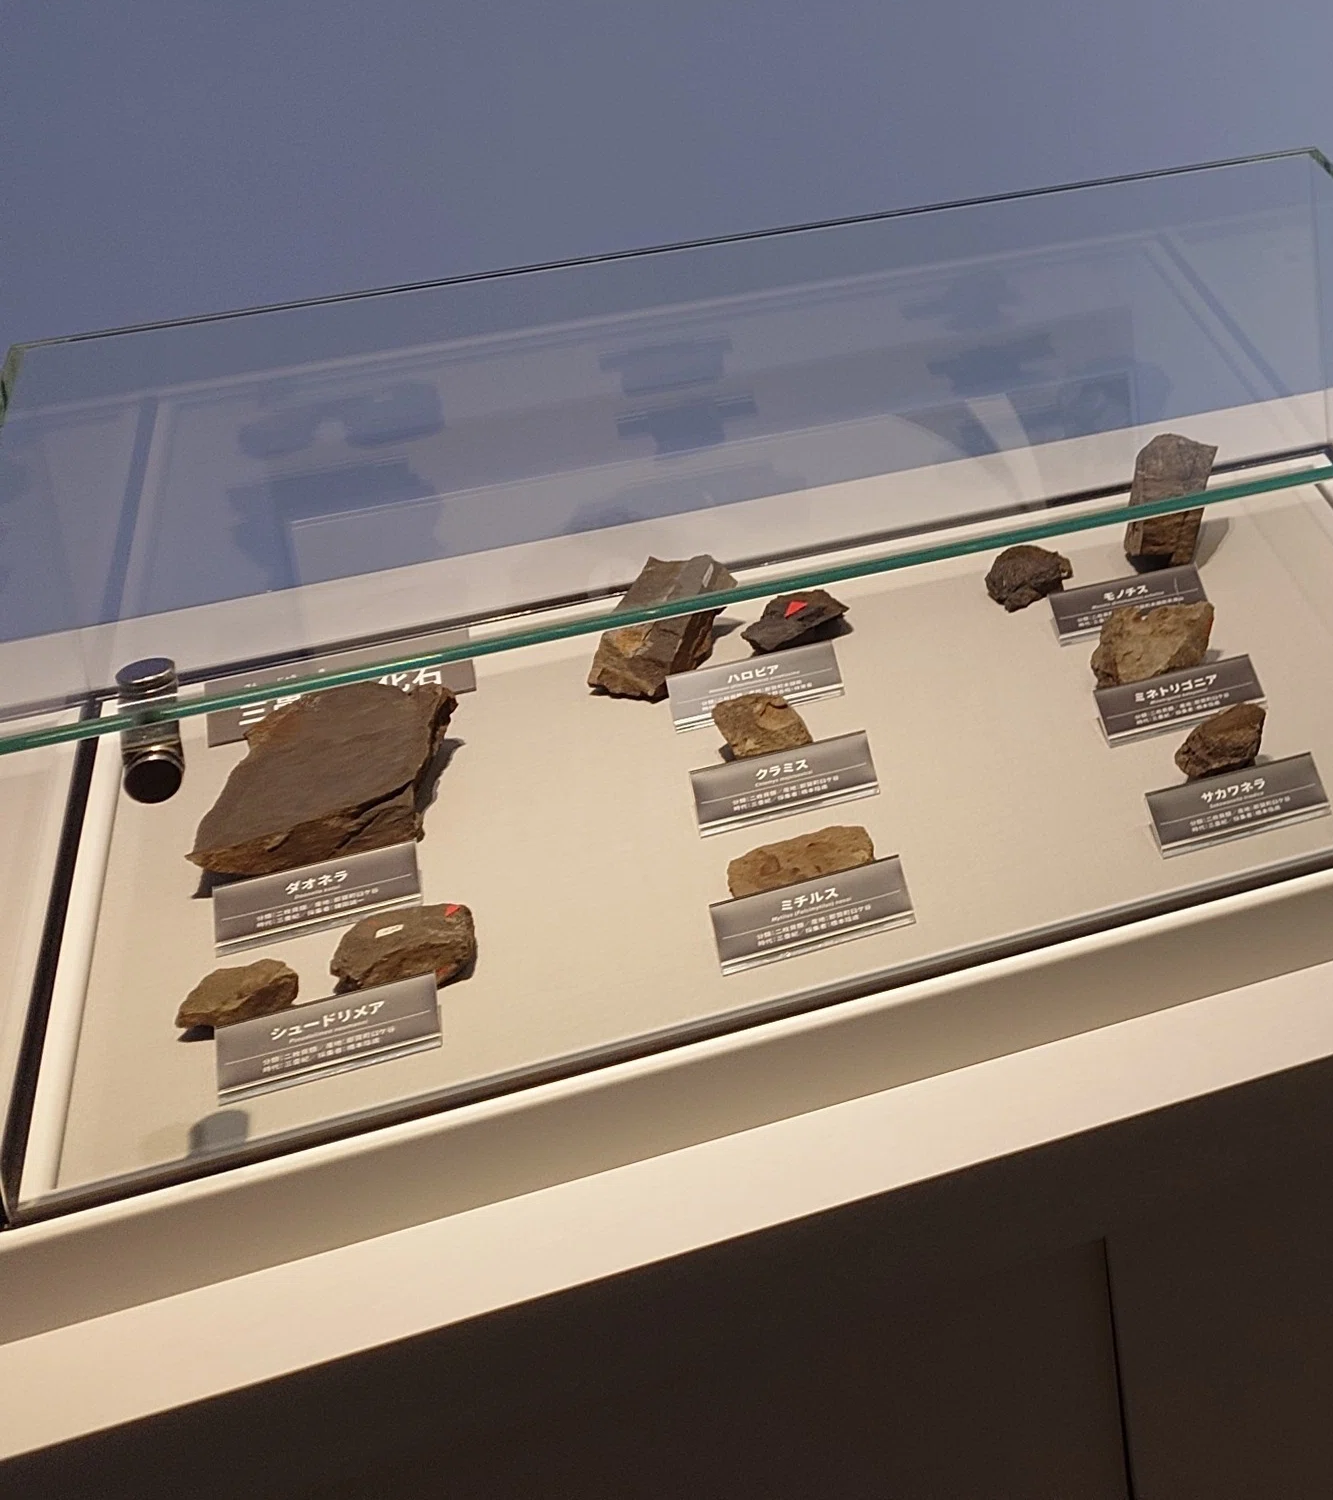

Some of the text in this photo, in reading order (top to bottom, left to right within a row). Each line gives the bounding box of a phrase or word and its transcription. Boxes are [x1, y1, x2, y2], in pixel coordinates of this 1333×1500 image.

[1104, 584, 1148, 601] モノチス
[727, 664, 779, 684] ハロビア
[1134, 674, 1217, 702] ミネトリゴニア
[755, 758, 809, 782] クラミス
[1201, 778, 1266, 803] サカワネラ
[286, 870, 348, 896] ダオネラ
[780, 887, 839, 911] ミチルス
[270, 1000, 385, 1041] シュードリメア
